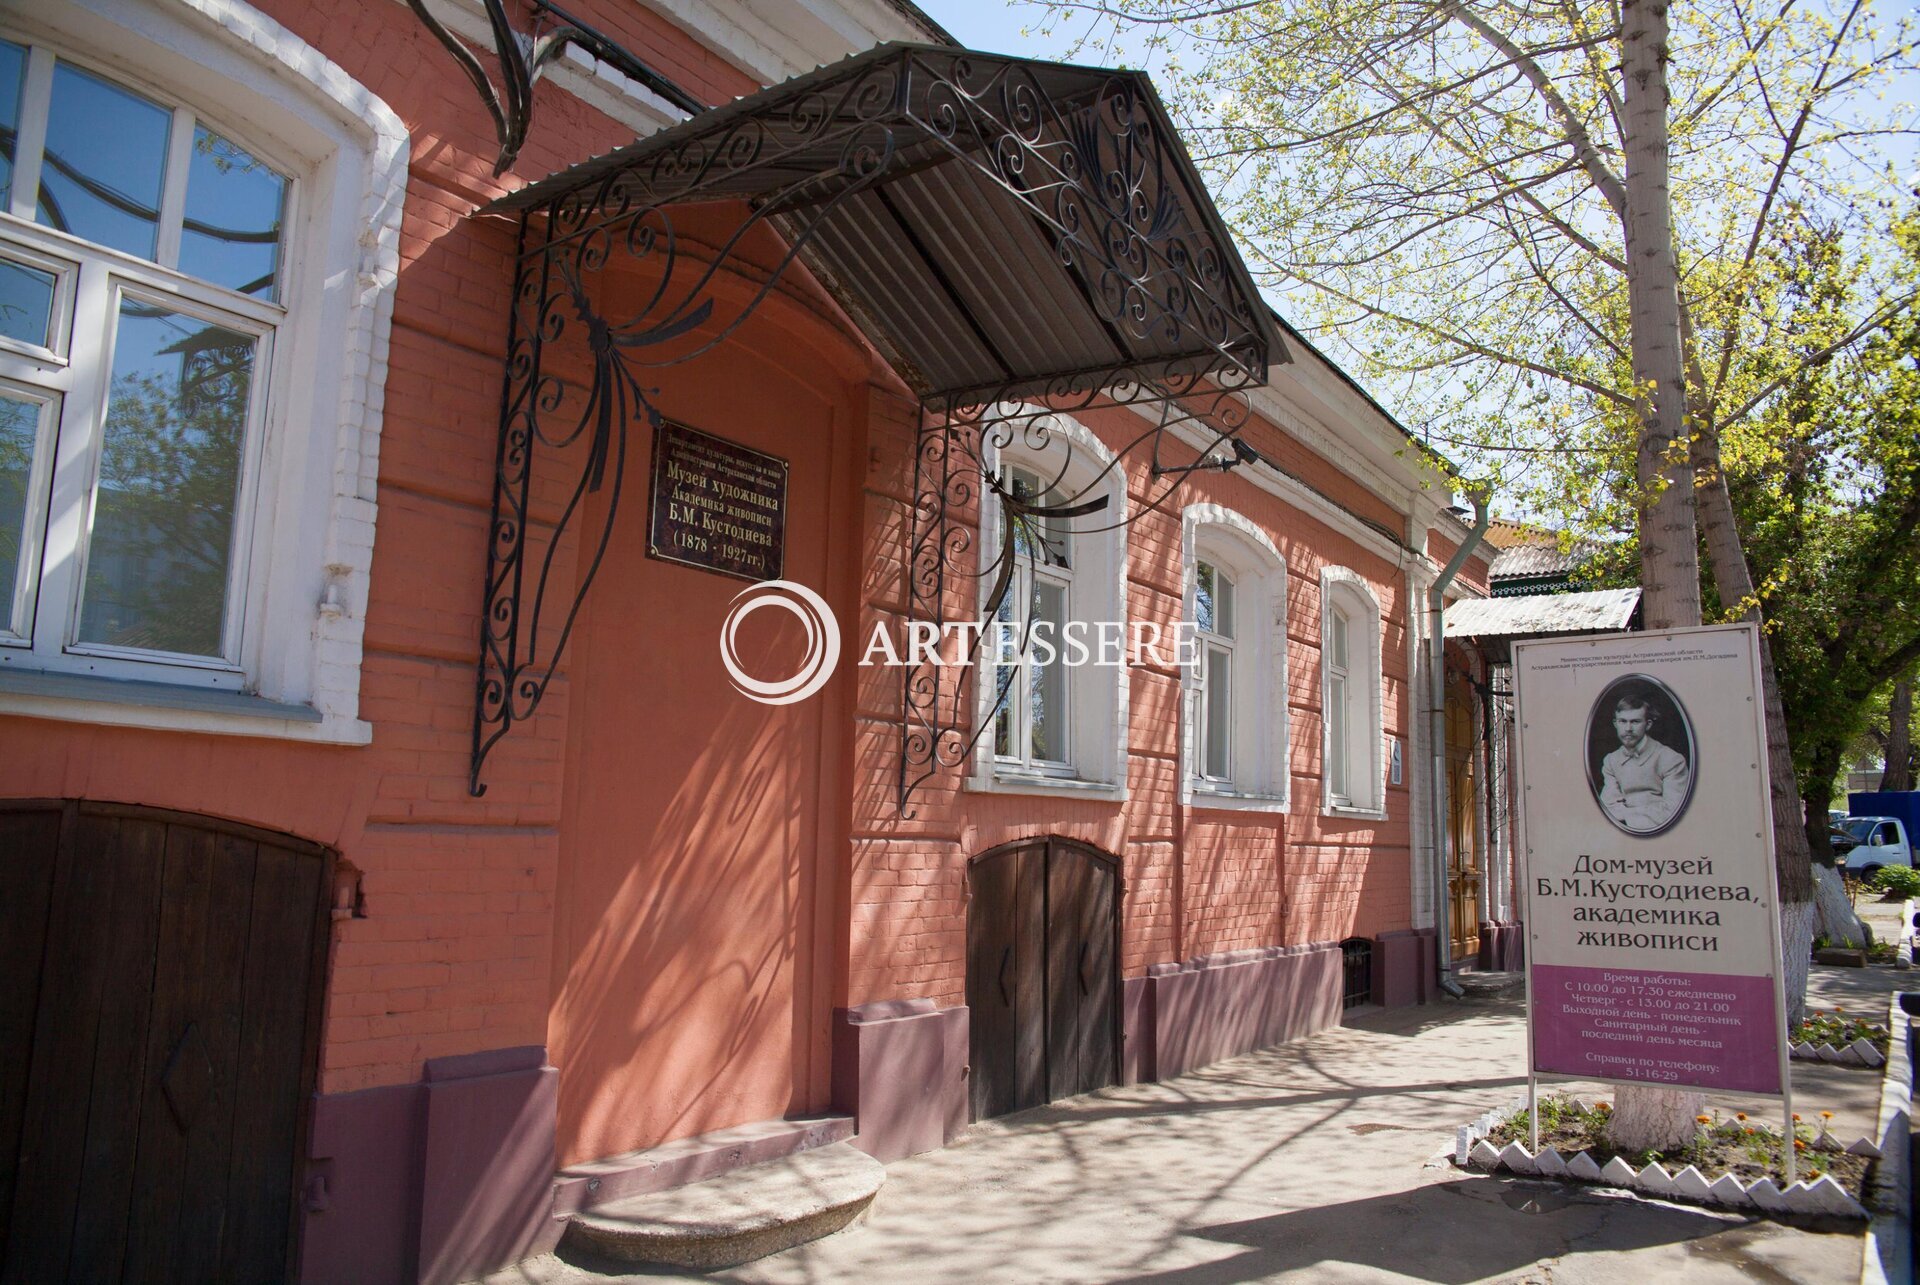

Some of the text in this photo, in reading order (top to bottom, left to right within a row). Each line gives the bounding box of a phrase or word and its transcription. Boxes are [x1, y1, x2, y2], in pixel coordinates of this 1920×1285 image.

[667, 460, 779, 511] Музей художника
[672, 485, 772, 527] Академика живописи
[669, 502, 772, 547] Б.М. Кустодиева
[722, 543, 766, 571] 1927гг.)
[1573, 855, 1713, 879] Дом-музей
[1573, 907, 1721, 926] академика
[1577, 930, 1718, 951] живописи
[1604, 972, 1691, 987] Время работы:
[1564, 981, 1736, 1001] С 10.00 до 17.30 ежедневно
[1571, 993, 1617, 1006] Четверг
[1639, 998, 1671, 1009] 13.00
[1674, 1001, 1690, 1010] до
[1694, 1002, 1730, 1013] 21.00
[1562, 1004, 1620, 1017] Выходной
[1622, 1009, 1650, 1019] день
[1661, 1012, 1742, 1026] понедельник
[1594, 1018, 1668, 1033] Санитарный
[1671, 1024, 1700, 1035] день
[1581, 1030, 1723, 1049] последний день месяца
[1585, 1052, 1720, 1073] Справки по телефону:
[1625, 1067, 1679, 1081] 51-16-29
